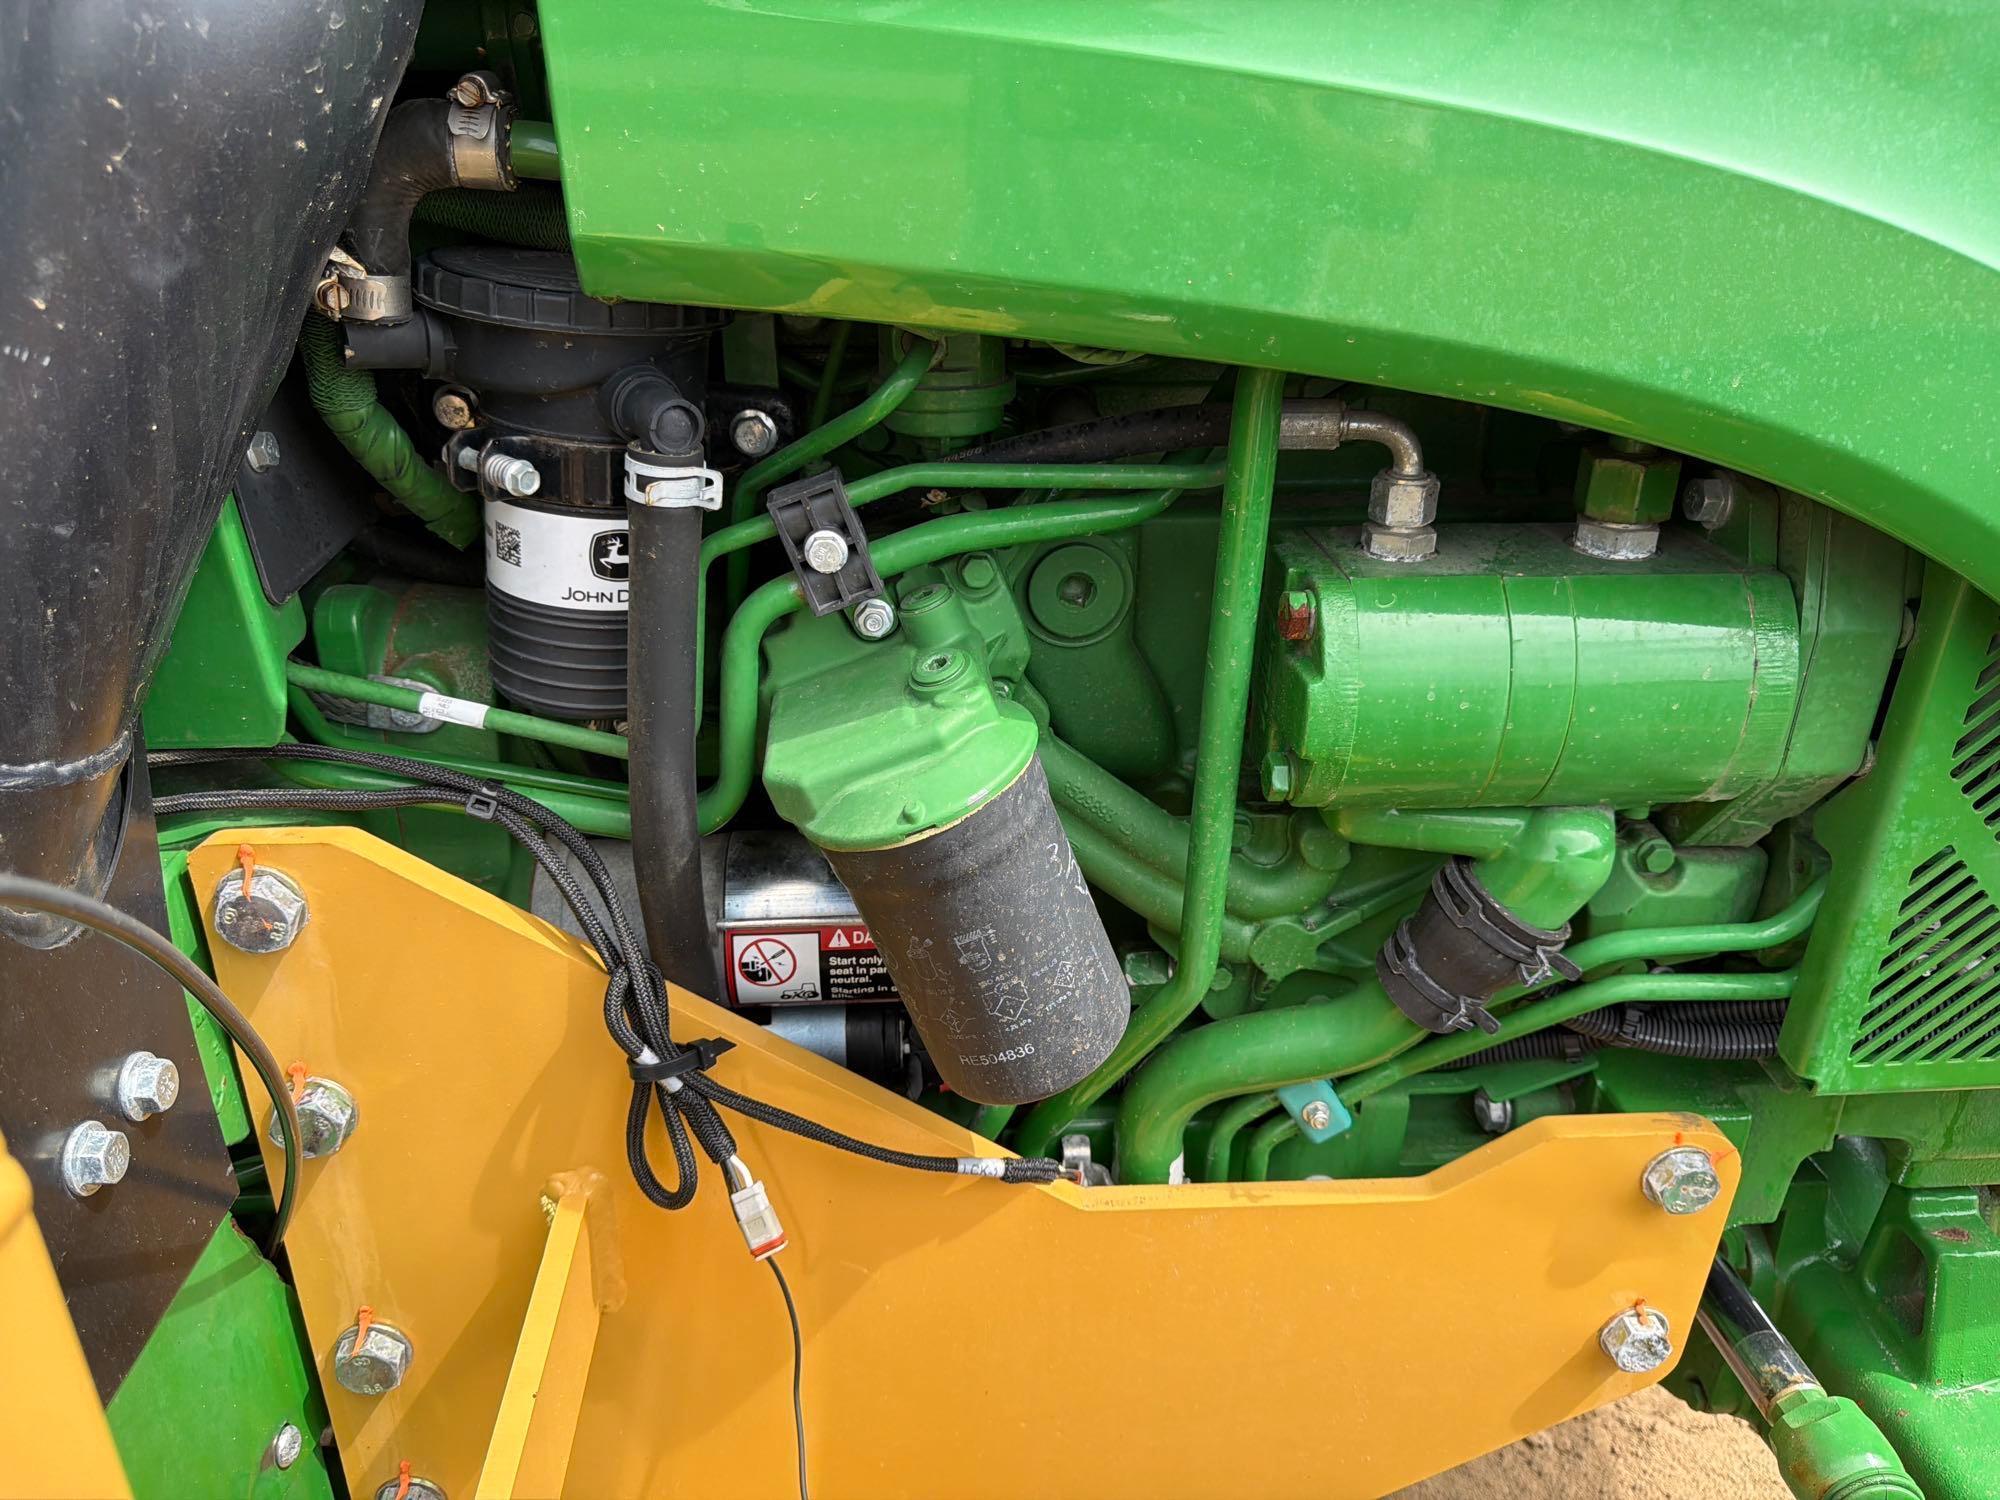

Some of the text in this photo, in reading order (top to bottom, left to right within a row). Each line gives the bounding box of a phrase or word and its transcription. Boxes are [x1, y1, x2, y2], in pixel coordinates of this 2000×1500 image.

[561, 587, 613, 603] JOHN
[829, 955, 883, 966] Start only
[829, 966, 853, 975] seat
[856, 966, 867, 975] in
[830, 975, 872, 984] neutral.
[831, 985, 875, 994] Starting
[959, 1043, 1035, 1066] RE504836
